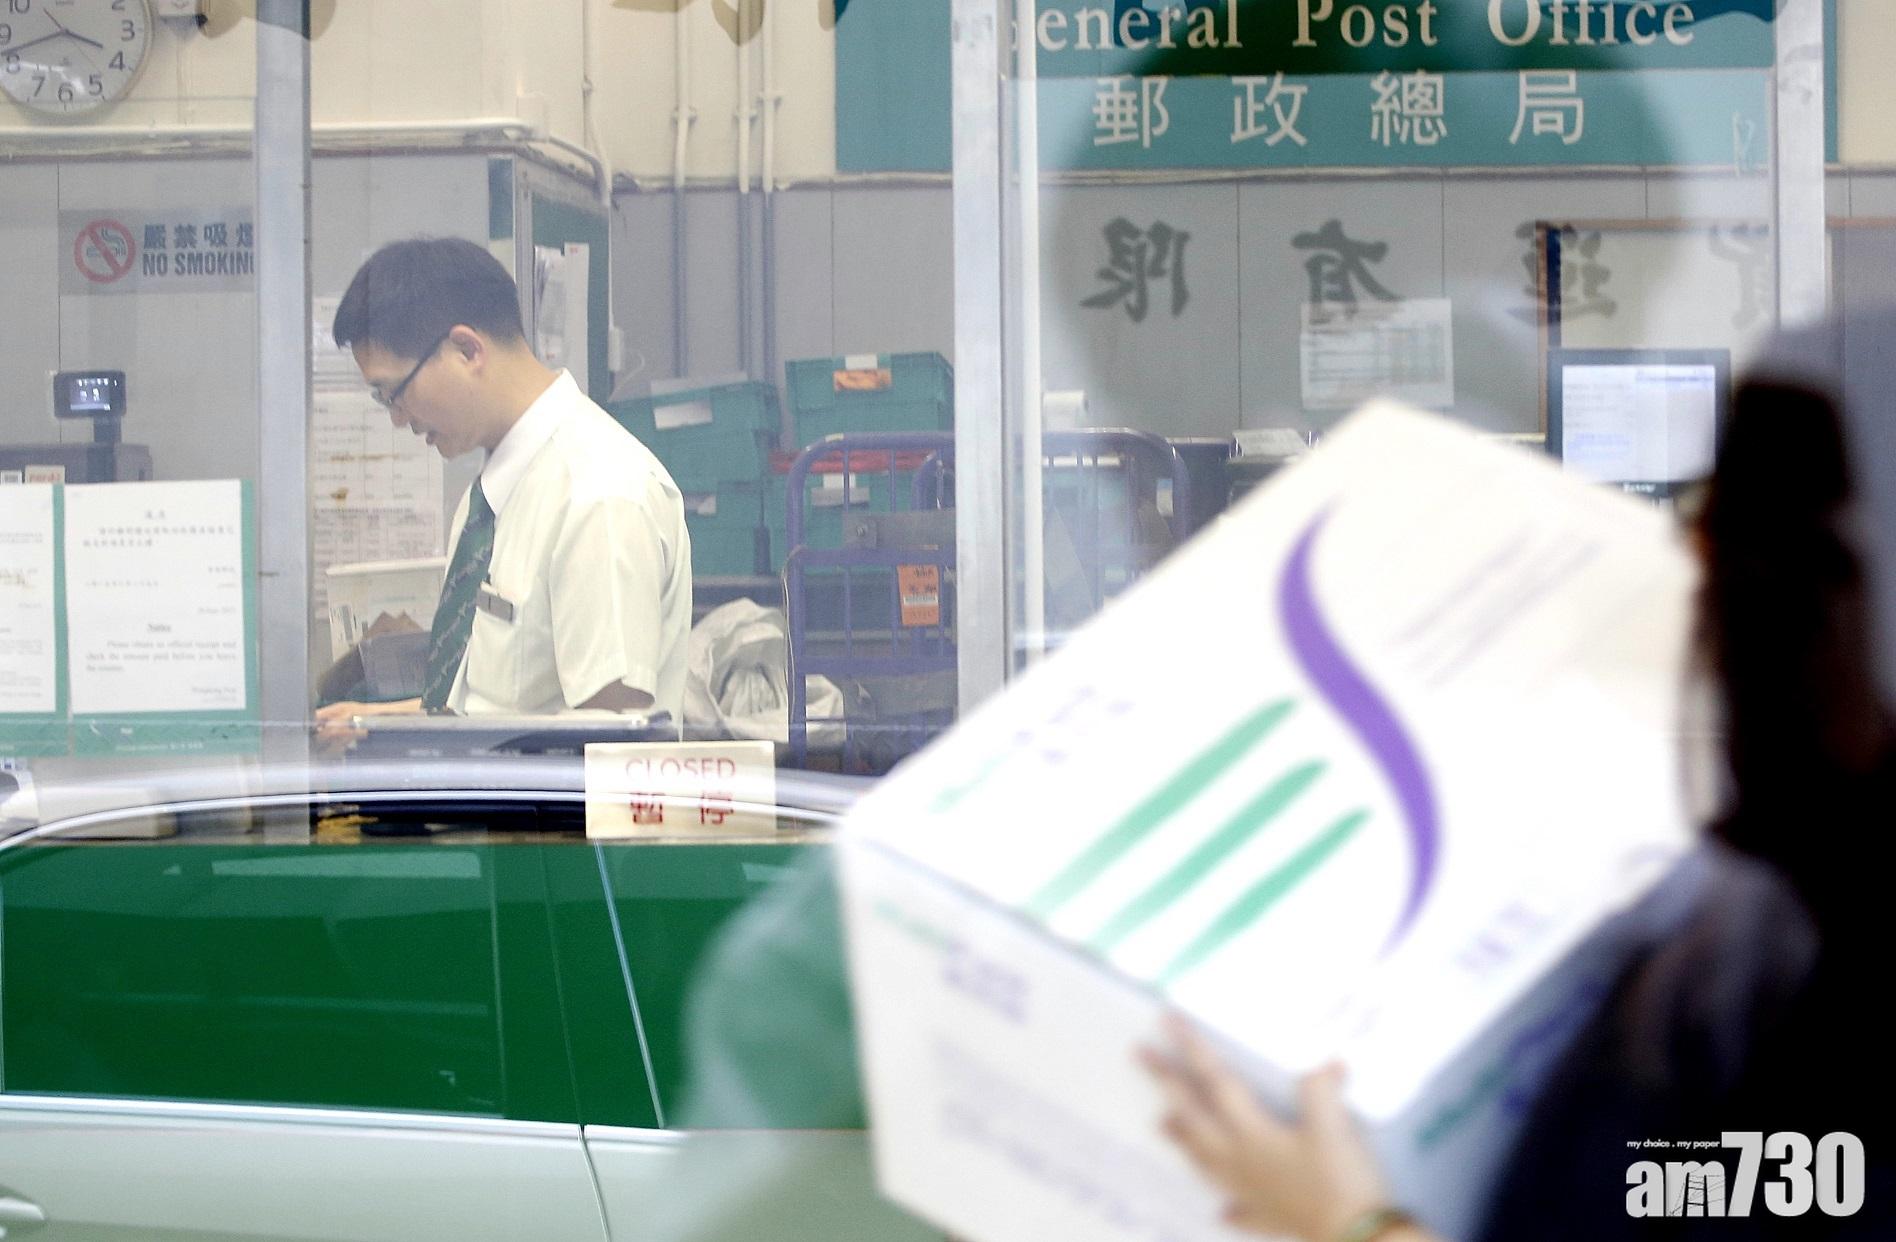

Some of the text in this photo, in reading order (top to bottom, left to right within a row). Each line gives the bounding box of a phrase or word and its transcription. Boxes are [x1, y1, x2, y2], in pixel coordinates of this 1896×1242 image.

[0, 23, 11, 45] 9
[121, 20, 135, 41] 3
[1010, 0, 1695, 50] eneral Post Office
[6, 53, 20, 74] 8
[109, 51, 125, 71] 4
[32, 75, 45, 97] 7
[58, 82, 73, 103] 6
[89, 74, 103, 96] 5
[1092, 68, 1585, 148] 郵政總局
[143, 252, 168, 276] NO
[626, 756, 736, 780] CLOSED
